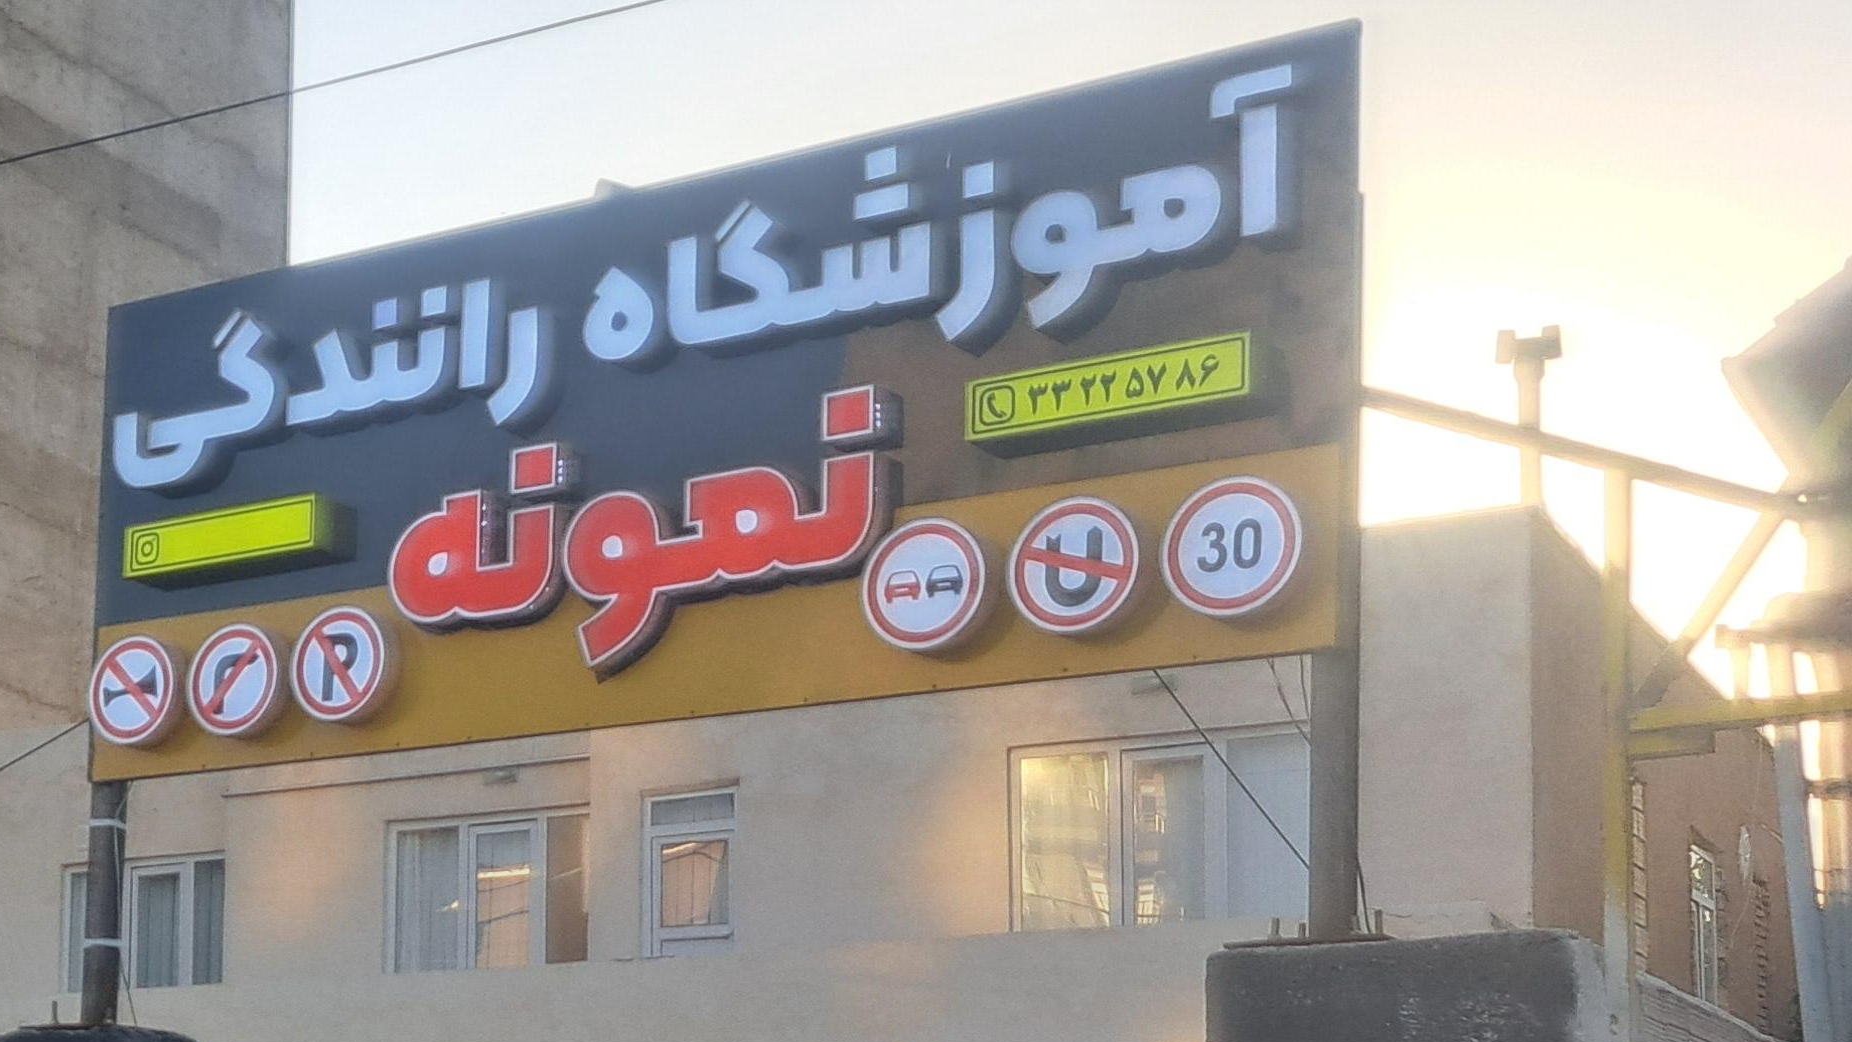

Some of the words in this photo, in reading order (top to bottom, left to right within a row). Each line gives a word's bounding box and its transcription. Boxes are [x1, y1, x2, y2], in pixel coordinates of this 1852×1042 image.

[581, 62, 1295, 364] آموزشگاه
[112, 276, 549, 490] رانندگی
[386, 384, 883, 670] نمونه
[1196, 517, 1263, 574] 30
